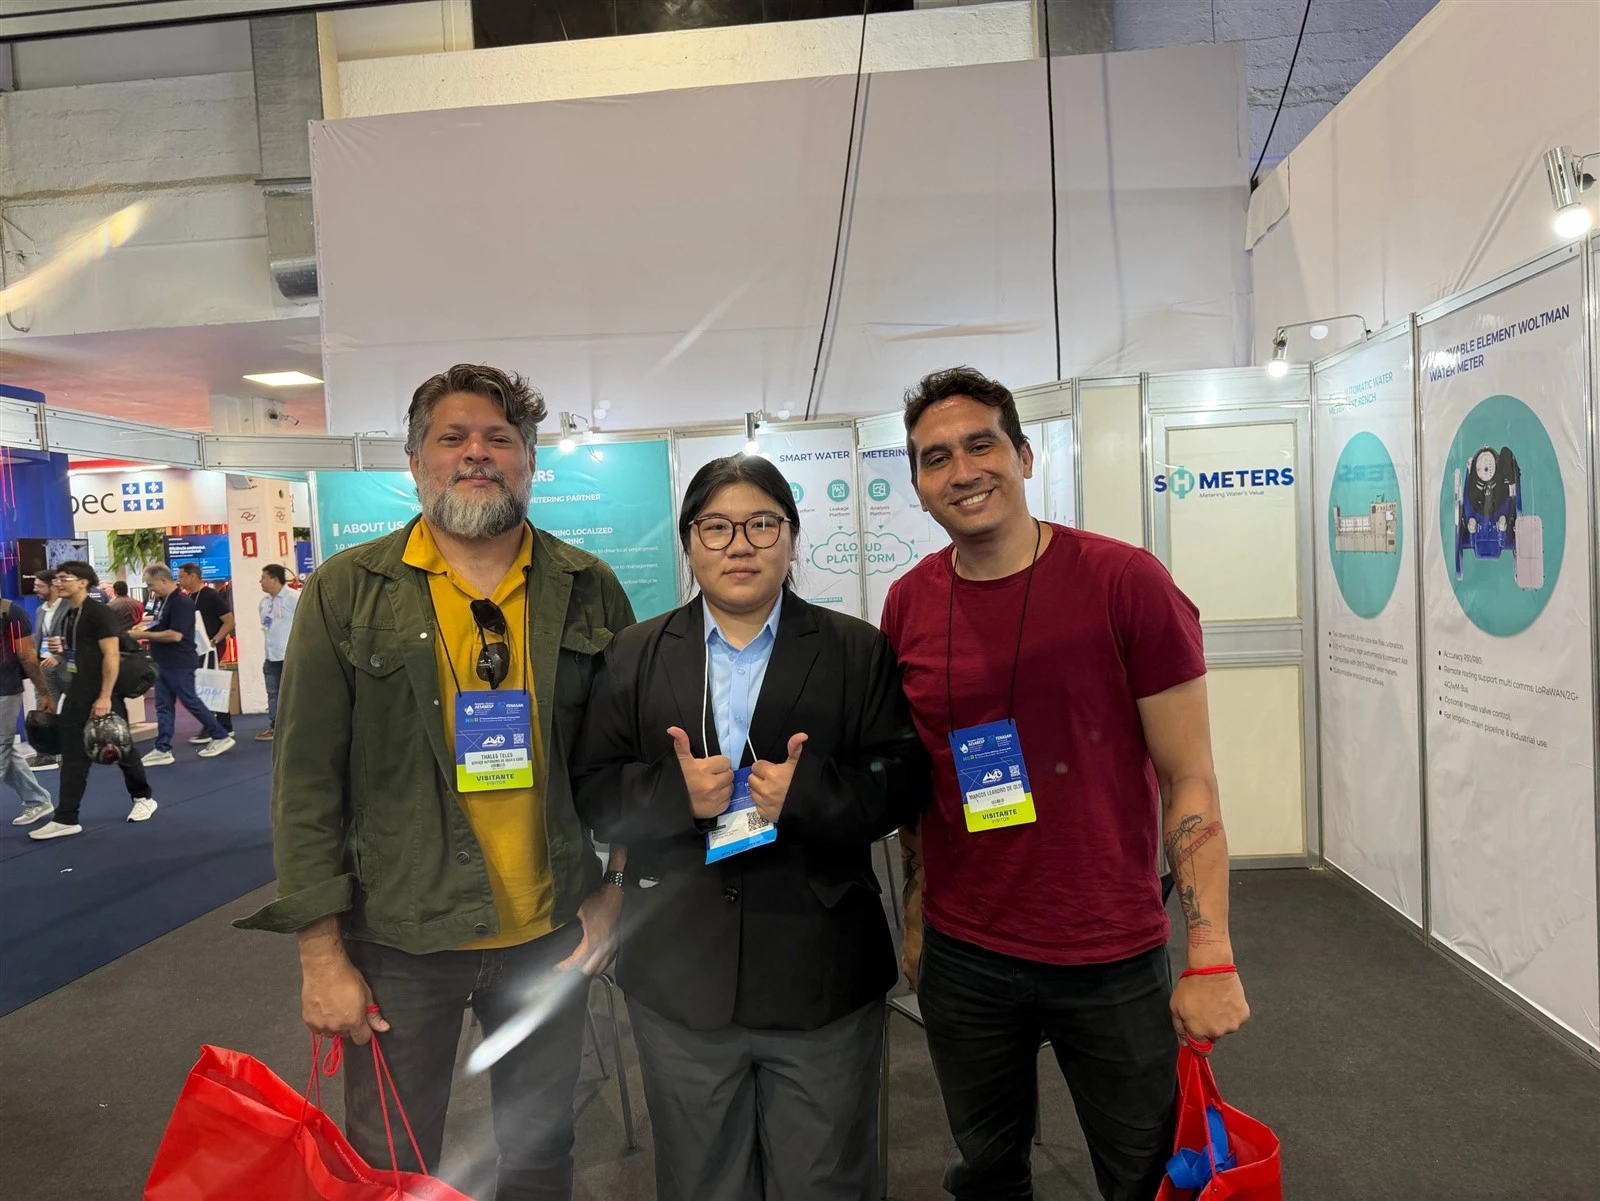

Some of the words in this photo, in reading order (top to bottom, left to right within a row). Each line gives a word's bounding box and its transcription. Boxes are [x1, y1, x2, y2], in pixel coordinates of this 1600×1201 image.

[1477, 325, 1516, 350] ELEMENT
[1518, 304, 1570, 335] WOLTMAN
[1429, 365, 1456, 383] WATER
[1457, 354, 1485, 375] METER
[1373, 371, 1394, 387] WATER
[779, 453, 814, 463] SMART
[814, 450, 850, 461] WATER
[1199, 467, 1295, 490] METERS
[566, 493, 601, 503] PARTNER
[1199, 491, 1226, 499] Metering
[1226, 490, 1248, 498] Water's
[342, 522, 385, 534] ABOUT
[387, 520, 405, 531] US
[572, 527, 613, 536] LOCALIZED
[1443, 651, 1463, 663] Accuracy
[1443, 665, 1462, 676] Remote
[1479, 706, 1492, 717] valve
[1471, 720, 1484, 730] main
[1484, 724, 1505, 736] pipeline
[1510, 730, 1535, 745] industrial
[476, 773, 515, 782] VISITANTE
[968, 791, 987, 801] MARCOS
[987, 787, 1007, 797] LEANDRO
[981, 808, 1018, 820] VISITANTE
[991, 817, 1010, 825] VISITOR
